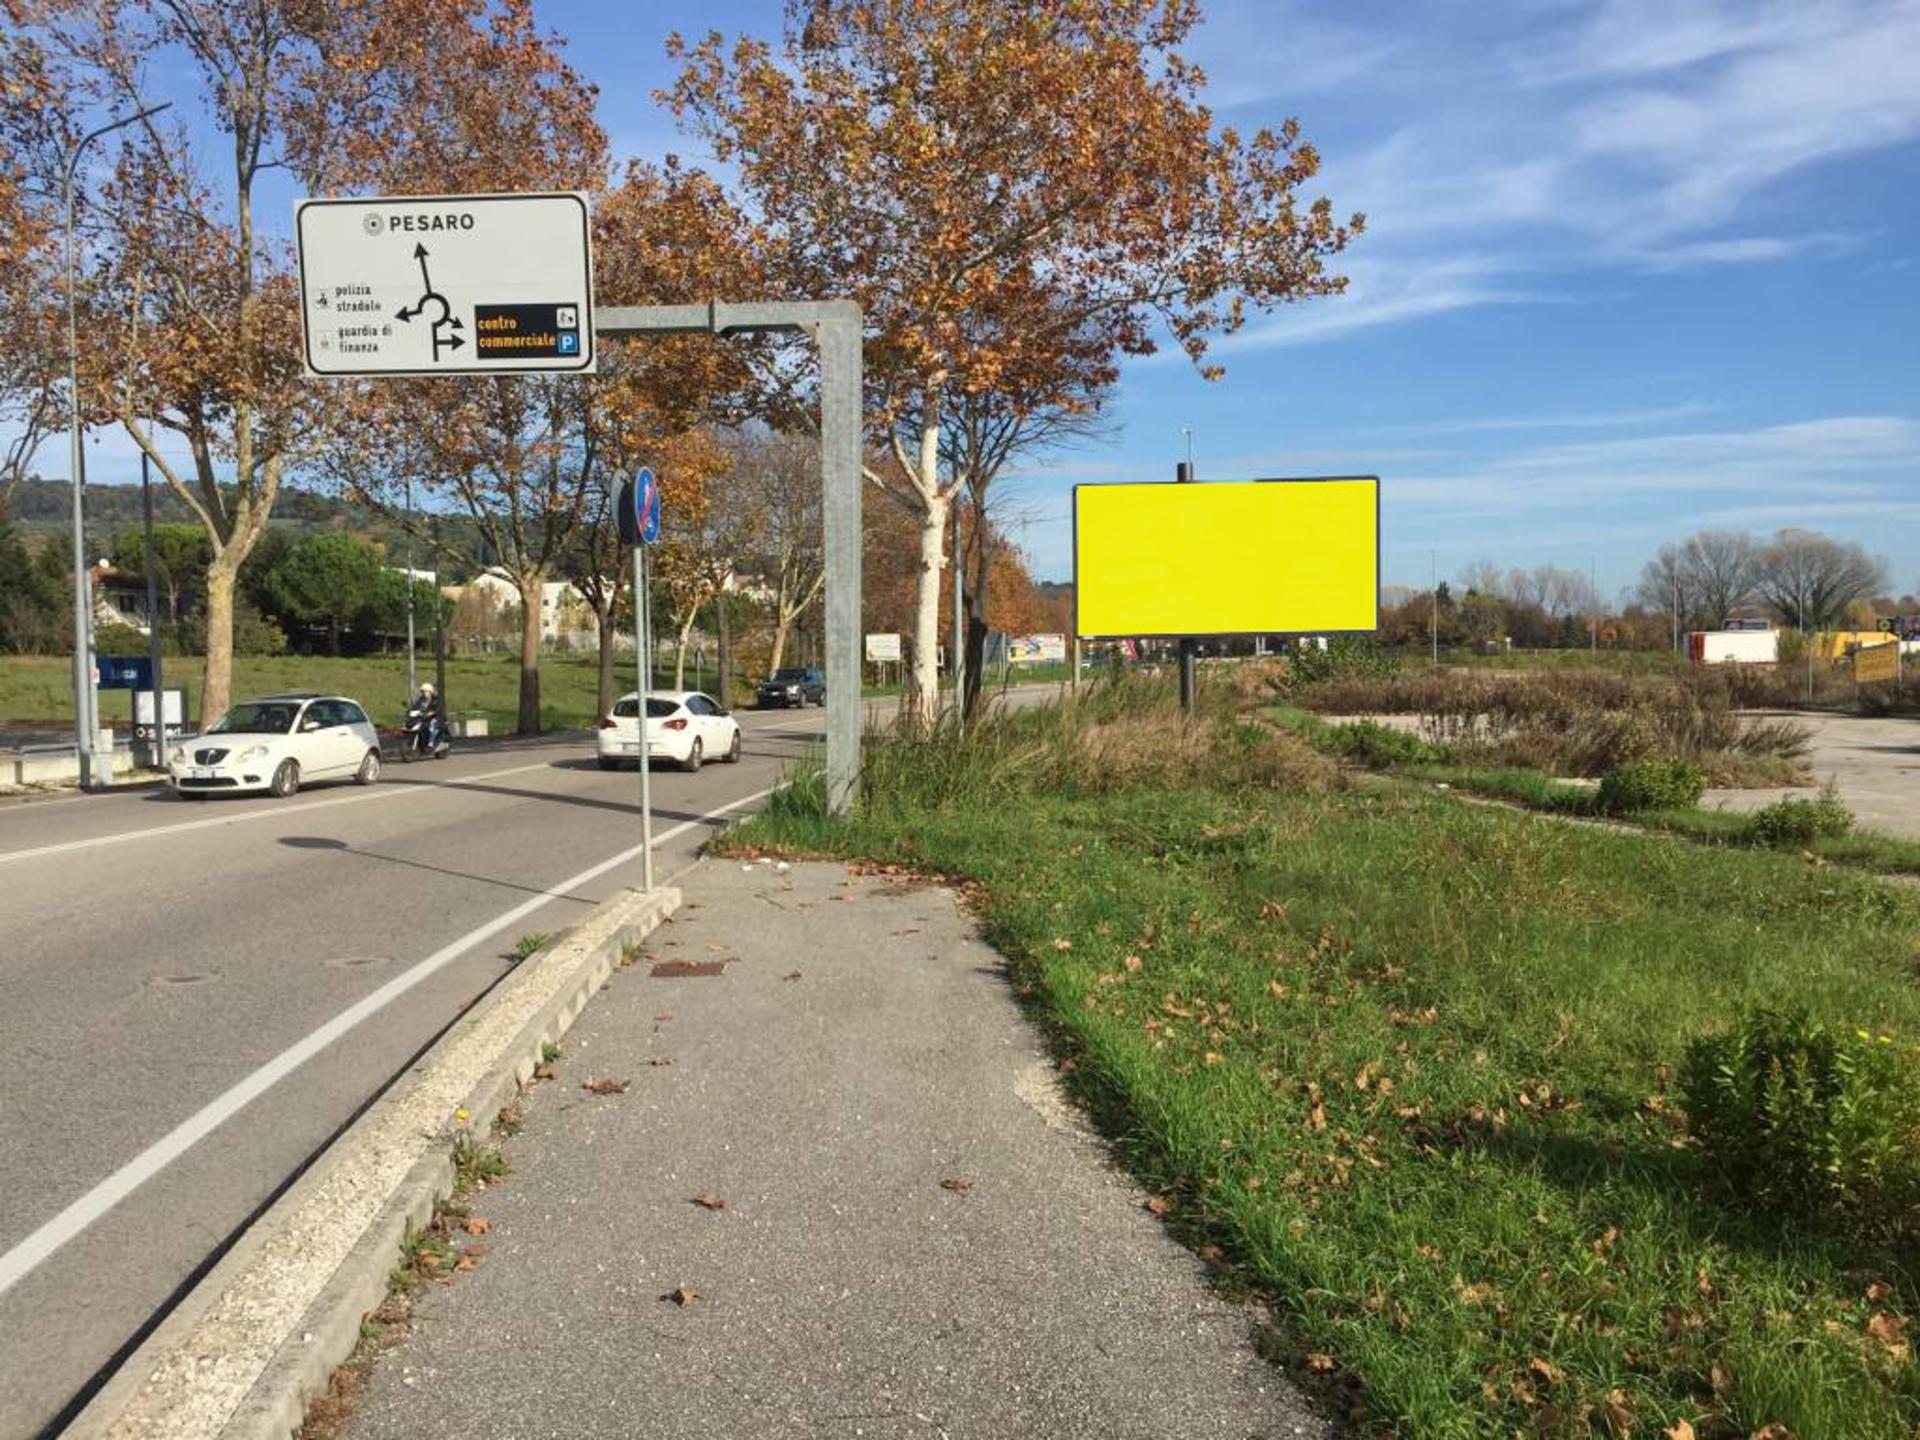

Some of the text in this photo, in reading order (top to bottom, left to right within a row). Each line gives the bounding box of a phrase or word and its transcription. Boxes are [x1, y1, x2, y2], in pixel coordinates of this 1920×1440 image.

[389, 213, 475, 231] PESARO
[335, 284, 371, 298] polizia
[336, 299, 381, 312] stradale
[478, 315, 517, 330] centro
[339, 325, 378, 339] guardia
[339, 341, 379, 353] finanza
[479, 332, 556, 348] commerciale
[561, 335, 573, 350] P
